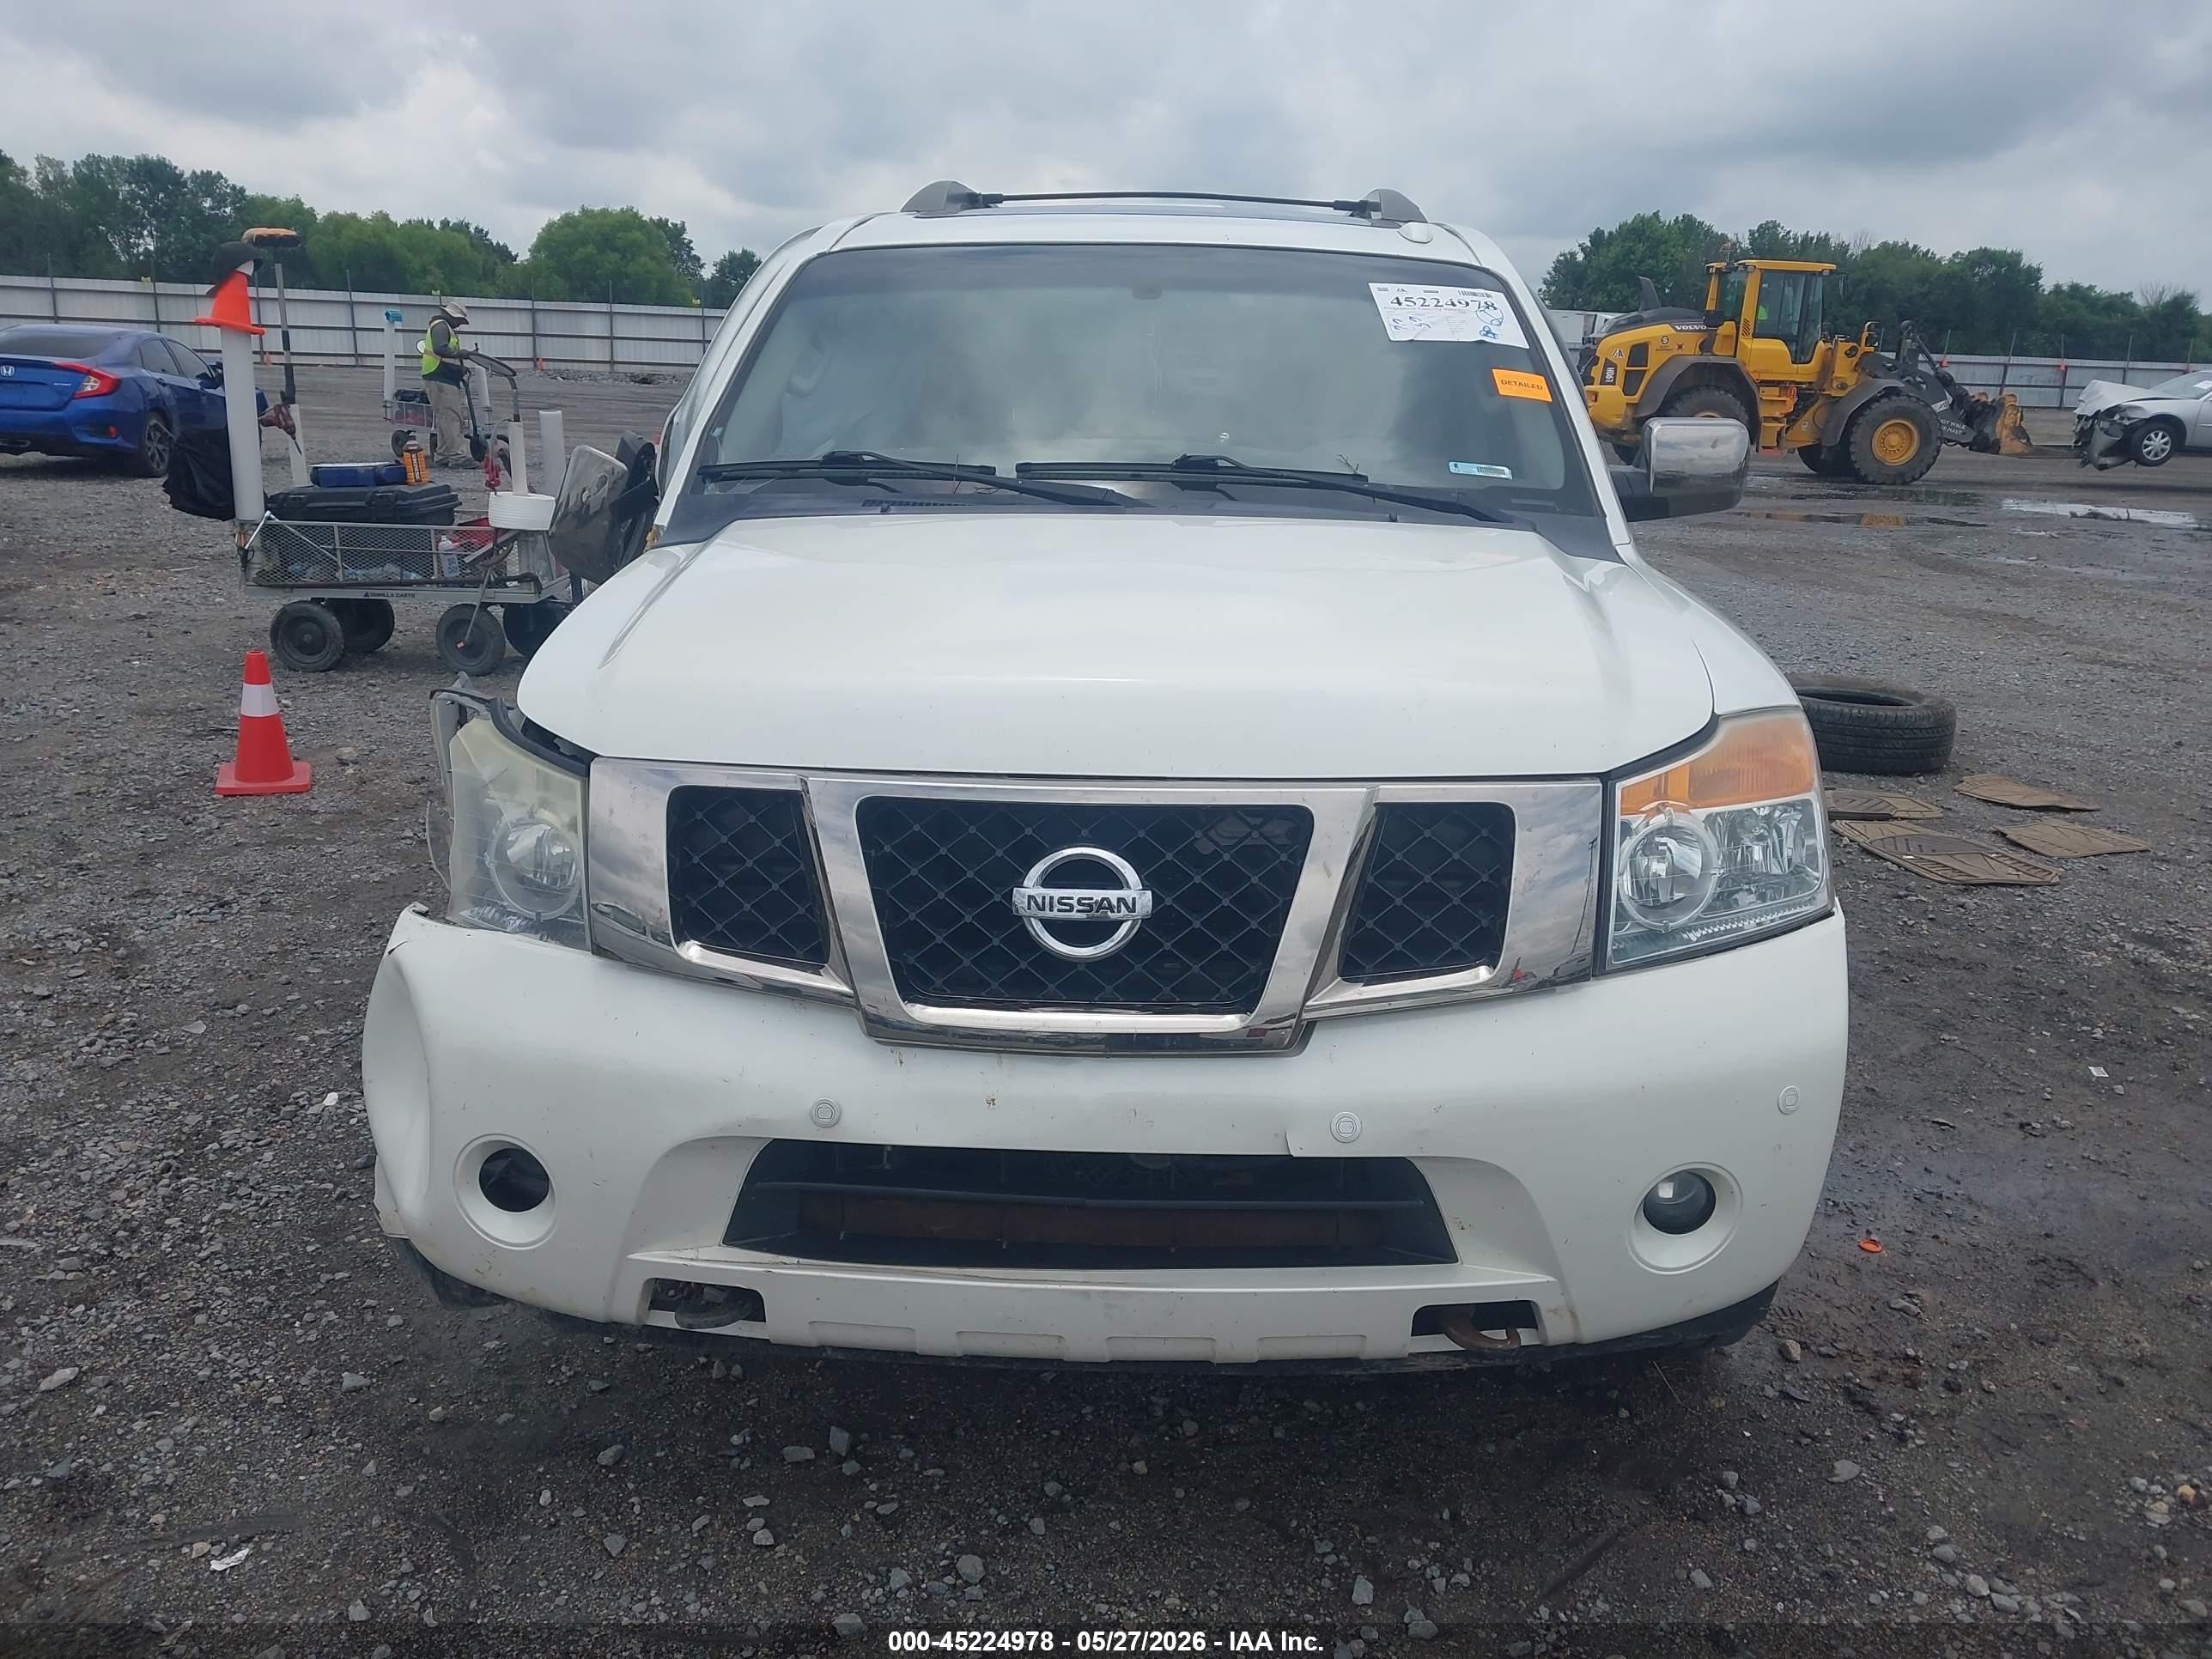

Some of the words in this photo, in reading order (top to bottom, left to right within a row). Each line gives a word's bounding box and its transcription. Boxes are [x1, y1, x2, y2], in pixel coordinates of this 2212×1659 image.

[1390, 295, 1498, 312] 45224978
[1500, 379, 1544, 391] DETAILED
[1950, 421, 1966, 430] WALK
[1026, 894, 1137, 915] NISSAN
